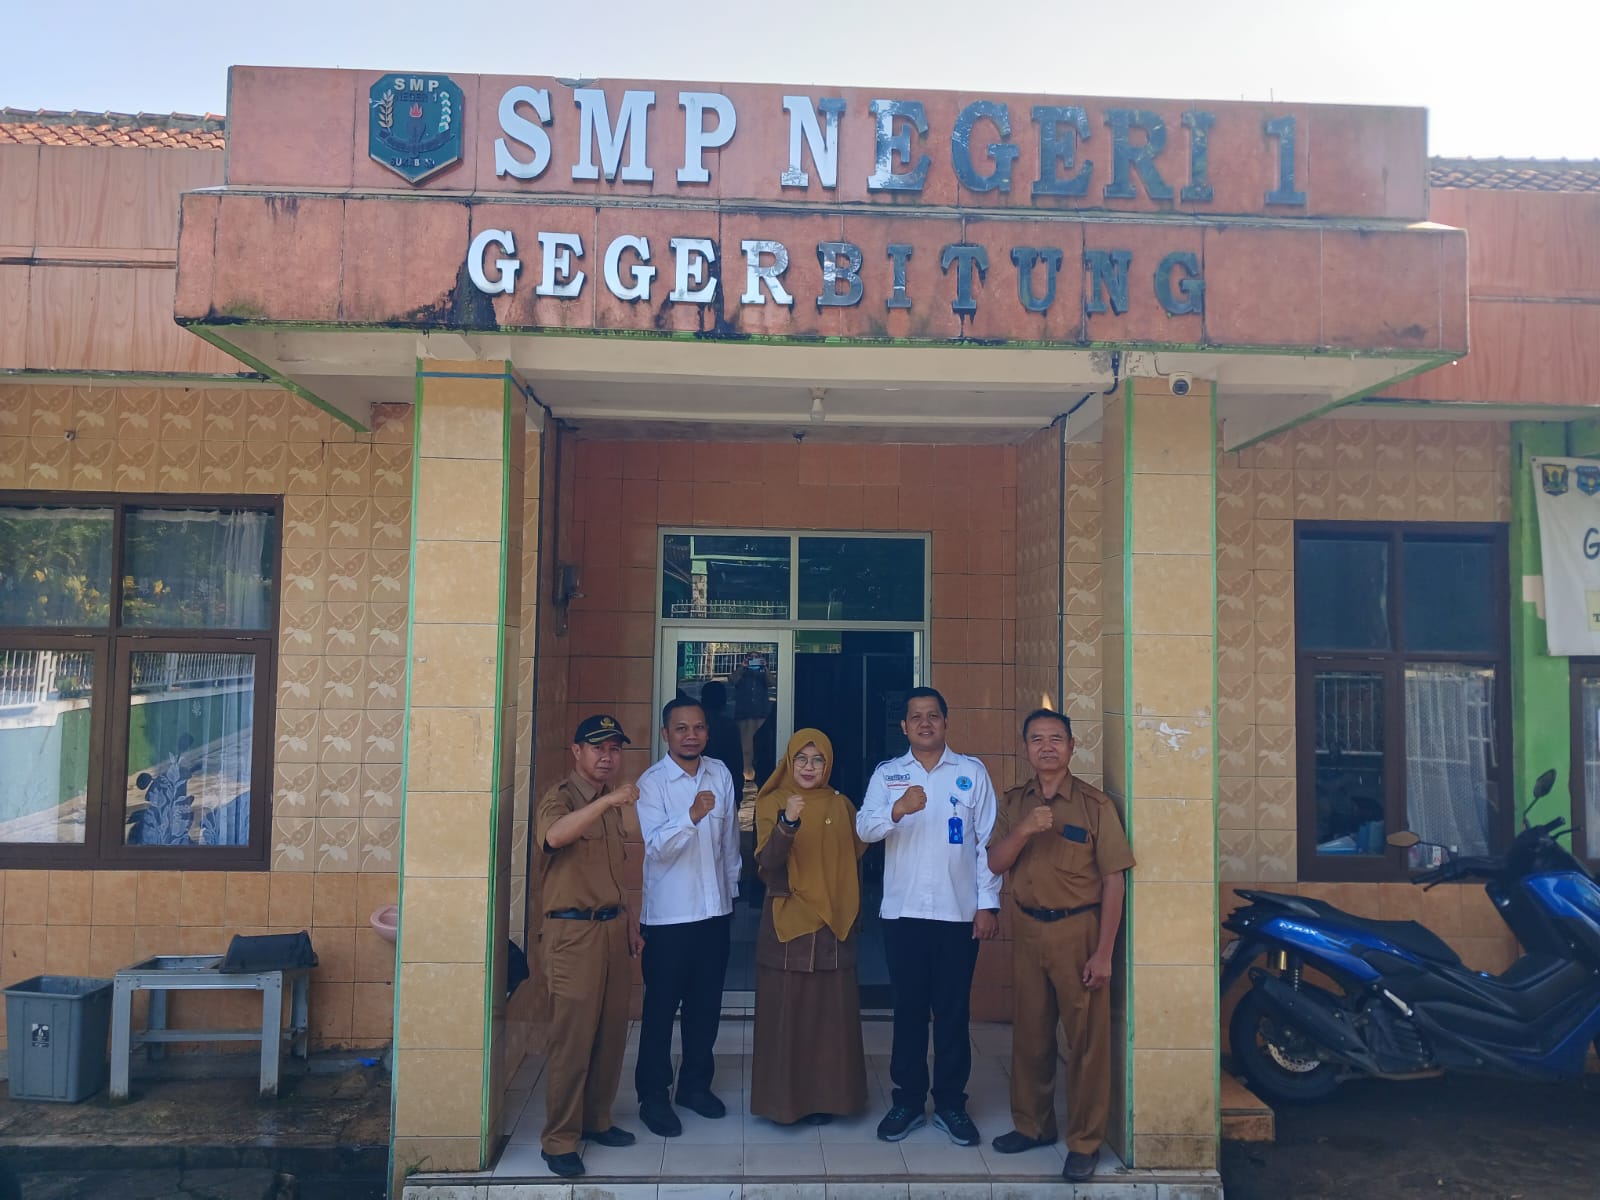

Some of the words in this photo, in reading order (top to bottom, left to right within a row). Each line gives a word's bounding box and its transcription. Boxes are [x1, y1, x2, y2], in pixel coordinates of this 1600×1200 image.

[394, 78, 439, 92] SMP
[494, 86, 738, 184] SMP
[780, 95, 1215, 202] NEGERI
[1264, 115, 1308, 206] 1
[467, 229, 1205, 315] GEGERBITUNG
